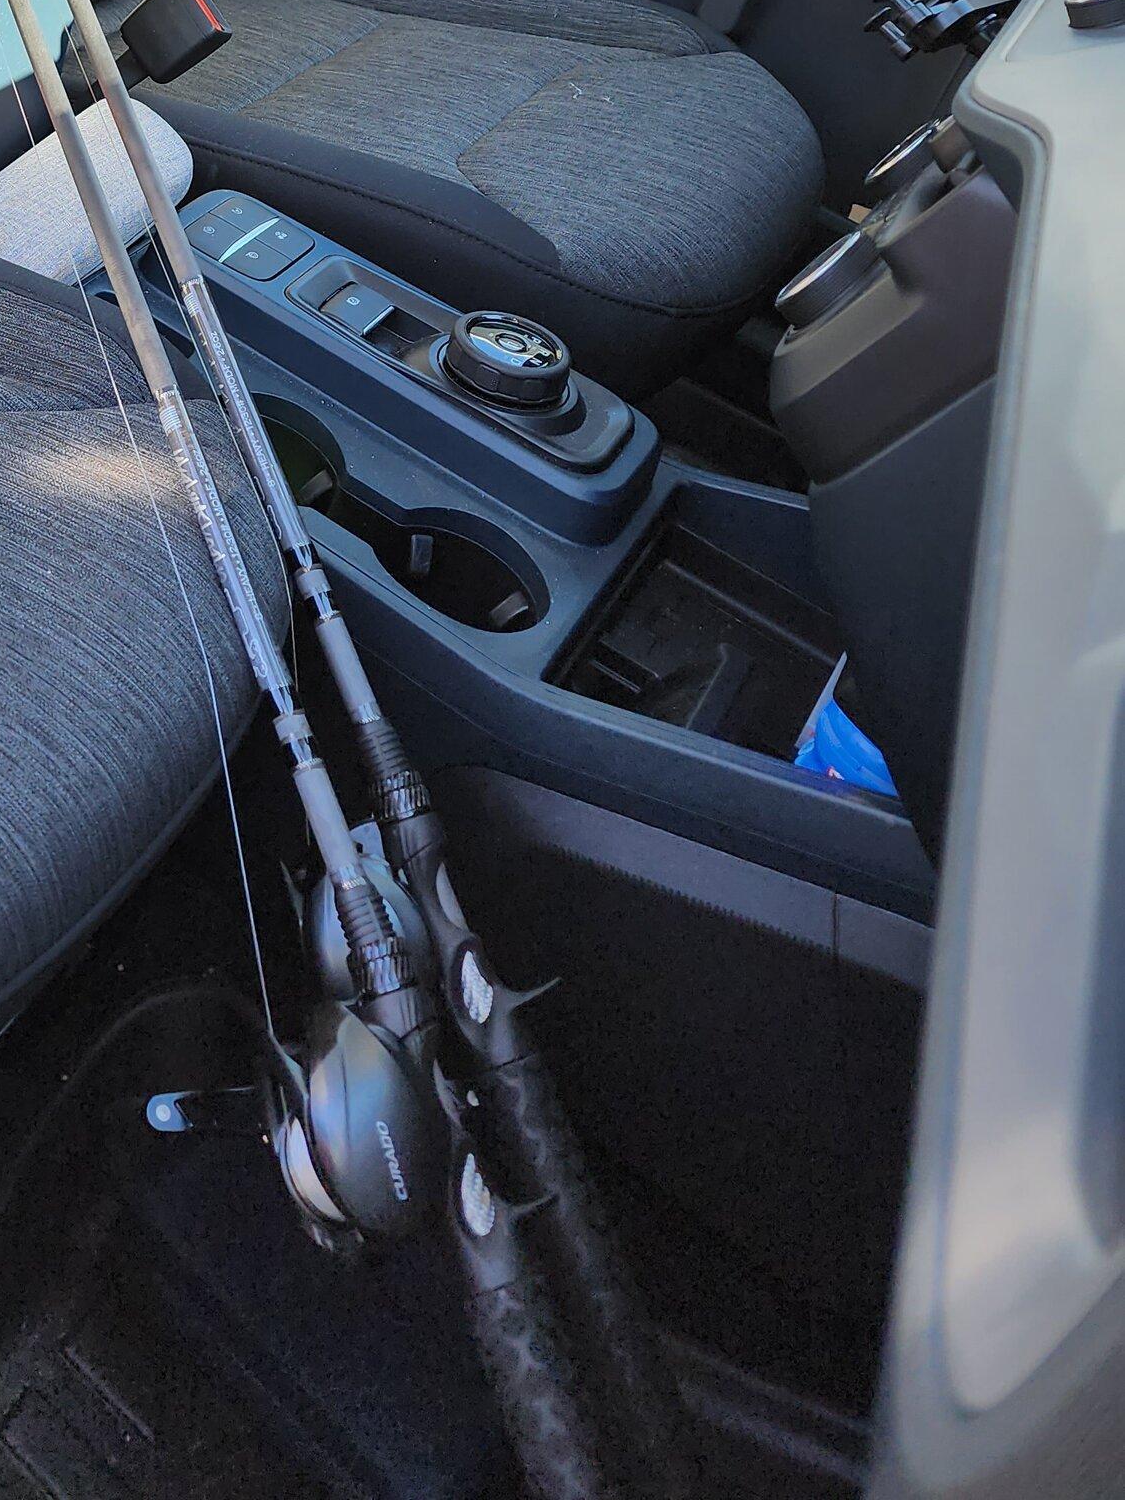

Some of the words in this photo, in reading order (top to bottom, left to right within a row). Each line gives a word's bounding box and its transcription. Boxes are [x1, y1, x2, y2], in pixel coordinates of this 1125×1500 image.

[250, 436, 270, 471] HEAVY
[235, 564, 257, 603] HEAVY
[376, 1120, 409, 1201] CURADO
